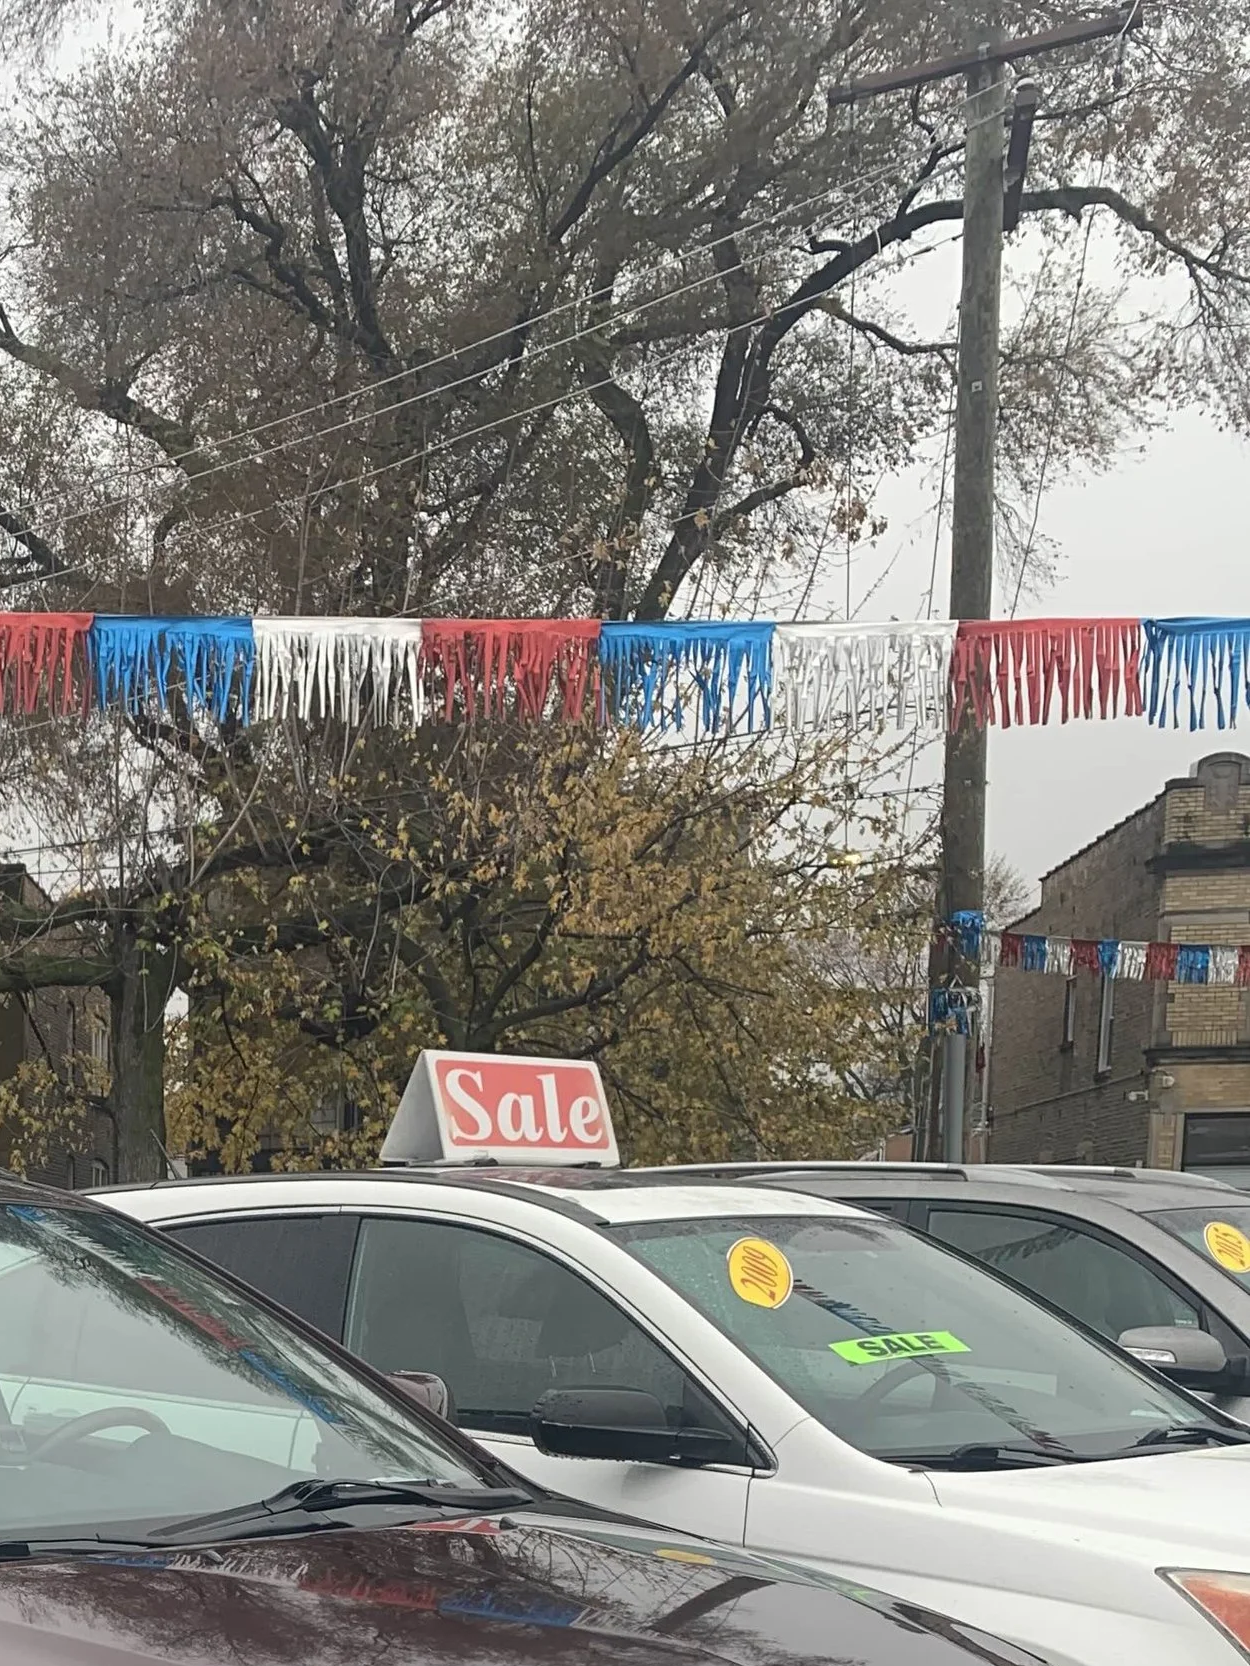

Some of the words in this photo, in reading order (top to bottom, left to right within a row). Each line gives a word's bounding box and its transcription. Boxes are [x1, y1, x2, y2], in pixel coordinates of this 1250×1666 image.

[445, 1068, 603, 1144] Sale
[740, 1245, 778, 1302] 2009
[857, 1334, 945, 1357] SALE
